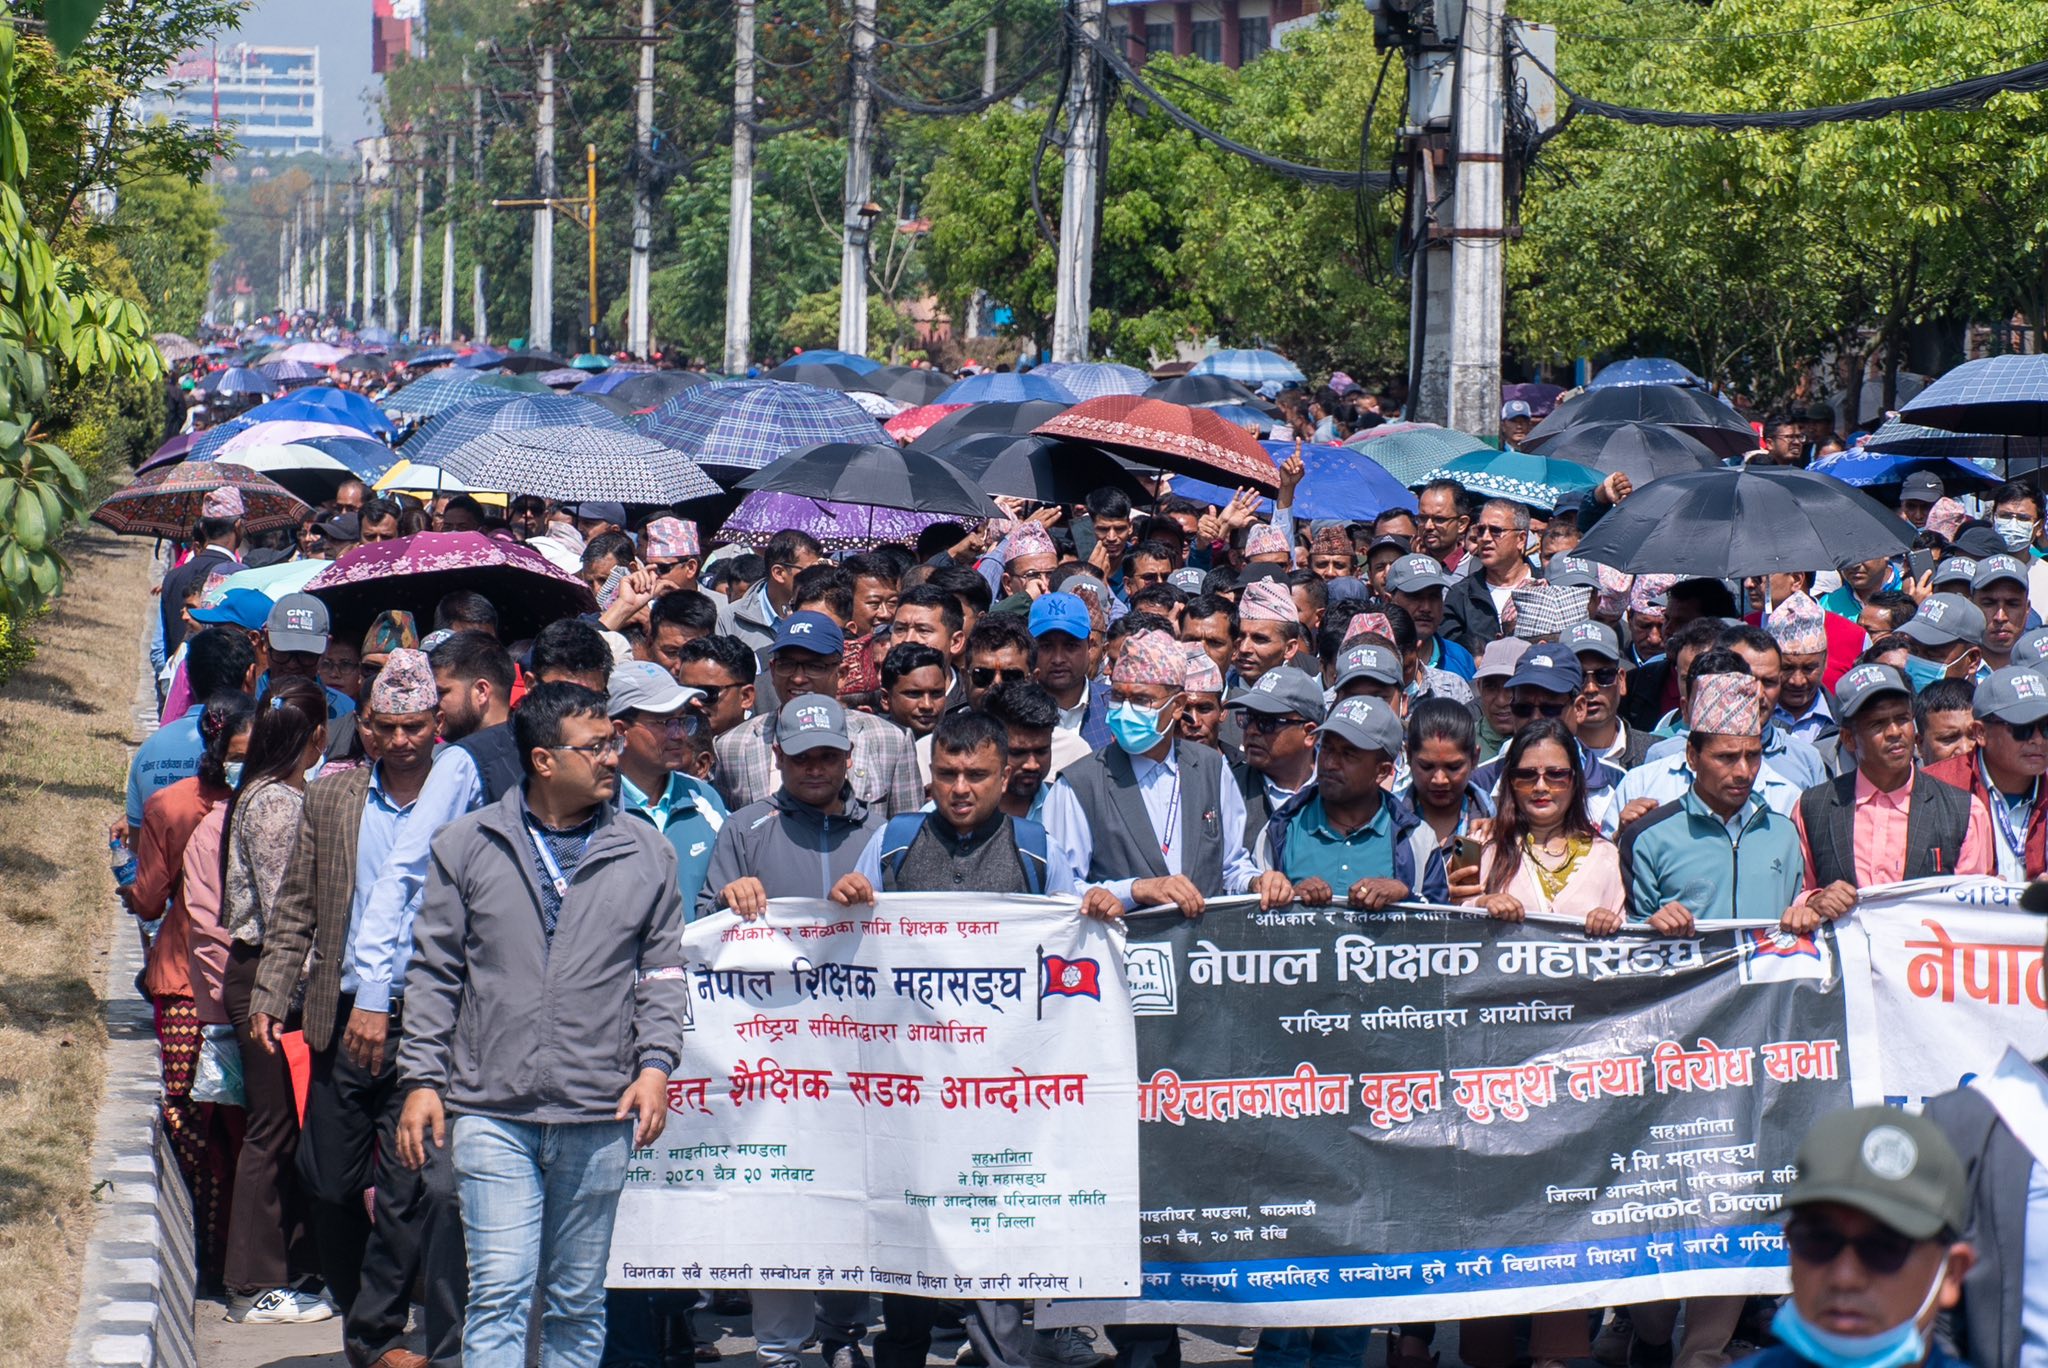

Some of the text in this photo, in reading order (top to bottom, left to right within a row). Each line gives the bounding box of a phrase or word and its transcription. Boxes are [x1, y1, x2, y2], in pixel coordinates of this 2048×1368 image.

[287, 609, 314, 618] CNT
[790, 623, 813, 635] UFC
[1348, 649, 1378, 659] CNT
[796, 706, 828, 717] CNT
[720, 924, 776, 943] अधिकार
[780, 926, 793, 942] र
[860, 917, 892, 935] लागि
[899, 916, 949, 936] शिक्षक
[956, 920, 1000, 938] एकता
[1324, 911, 1337, 925] र
[1188, 940, 1321, 986] नेपाल
[1335, 934, 1483, 983] शिक्षक
[693, 956, 1027, 1014] नेपाल शिक्षक महासङ्घ
[734, 1013, 988, 1044] राष्ट्रिय समितिद्वारा आयोजित
[1280, 1000, 1575, 1037] राष्ट्रिय समितिद्वारा आयोजित
[728, 1056, 833, 1108] शैक्षिक
[847, 1071, 924, 1109] सडक
[940, 1066, 1089, 1114] आन्दोलन
[1359, 1070, 1443, 1129] बृहत
[1566, 1055, 1647, 1103] तथा
[1651, 1039, 1756, 1097] विरोध
[1760, 1038, 1841, 1084] सभा
[1650, 1117, 1736, 1141] सहभागिता
[668, 1142, 732, 1161] माइतीघर
[737, 1143, 788, 1159] मण्डला
[971, 1148, 1034, 1168] सहभागिता
[665, 1168, 704, 1185] २०८१
[713, 1162, 736, 1182] चैत्र
[744, 1168, 762, 1183] २०
[770, 1164, 816, 1182] गतेबाट
[904, 1189, 1108, 1209] जिल्ला आन्दोलन परिचालन समिति
[1546, 1184, 1599, 1205] जिल्ला
[1605, 1178, 1678, 1201] आन्दोलन
[1686, 1169, 1766, 1196] परिचालन
[1591, 1191, 1784, 1227] कालिकोट जिल्ला
[970, 1211, 1036, 1234] मुगु जिल्ला
[1140, 1234, 1170, 1246] ०८१
[1210, 1231, 1228, 1244] २०
[1233, 1226, 1254, 1243] गते
[1260, 1224, 1289, 1241] देखि
[1180, 1268, 1239, 1293] सम्पूर्ण
[1339, 1263, 1413, 1284] सम्बोधन
[1421, 1259, 1446, 1285] हुने
[1456, 1255, 1493, 1278] गरी
[1501, 1252, 1578, 1275] विद्यालय
[1586, 1246, 1637, 1267] शिक्षा
[1646, 1240, 1674, 1263] ऐन
[1683, 1233, 1729, 1256] जारी
[622, 1262, 675, 1280] विगतका
[682, 1261, 701, 1282] सबै
[760, 1264, 811, 1282] सम्बोधन
[817, 1265, 834, 1286] हुने
[841, 1265, 864, 1285] गरी
[870, 1266, 913, 1285] विद्यालय
[917, 1270, 947, 1290] शिक्षा
[954, 1274, 972, 1293] ऐन
[979, 1273, 1011, 1291] जारी
[1017, 1273, 1070, 1293] गरियोस्
